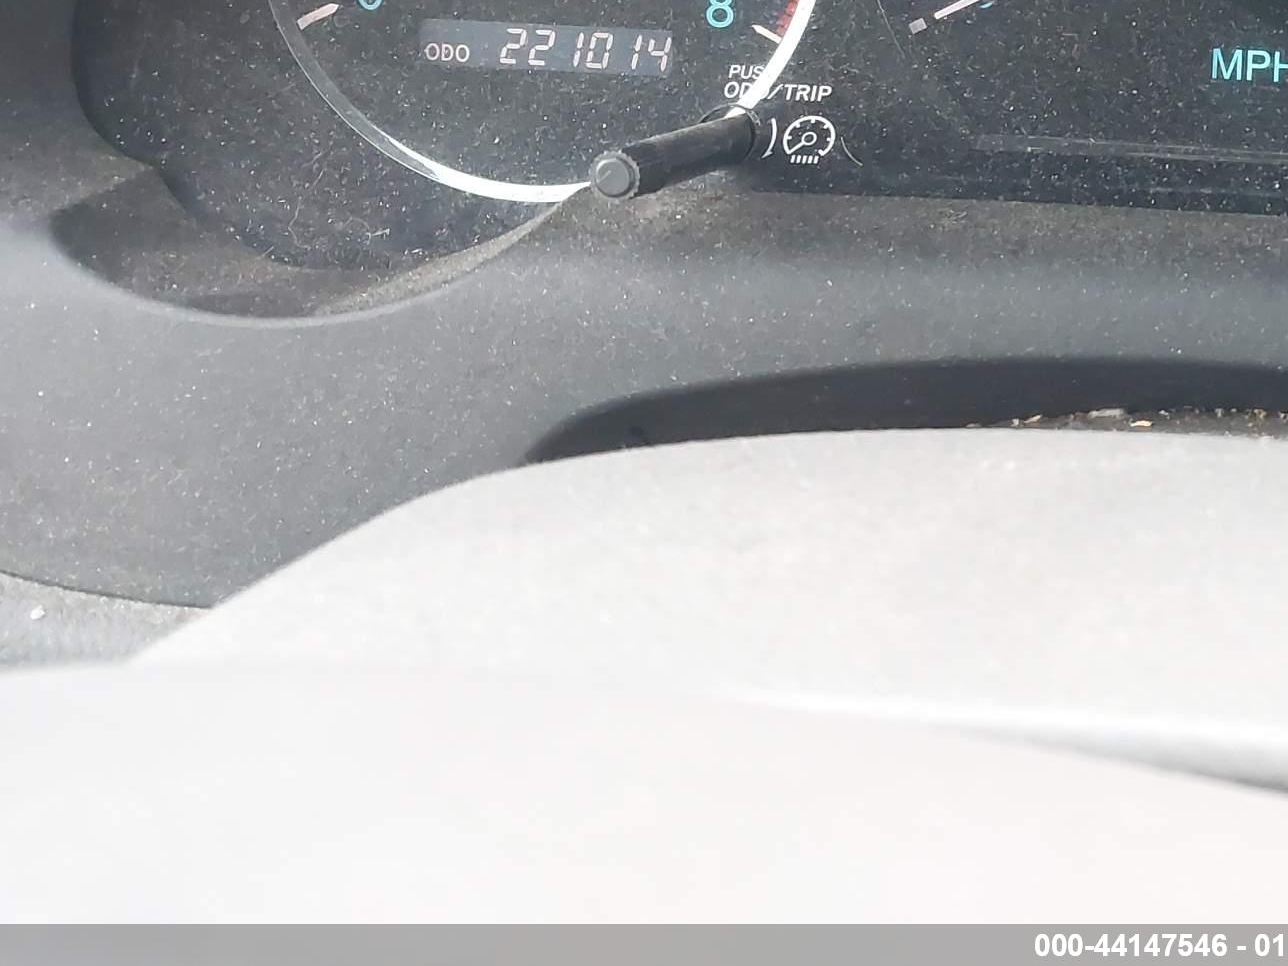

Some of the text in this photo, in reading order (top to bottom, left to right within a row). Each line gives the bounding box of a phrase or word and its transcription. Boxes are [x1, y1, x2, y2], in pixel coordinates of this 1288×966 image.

[424, 28, 671, 73] ODO 221014
[729, 64, 768, 80] PUS
